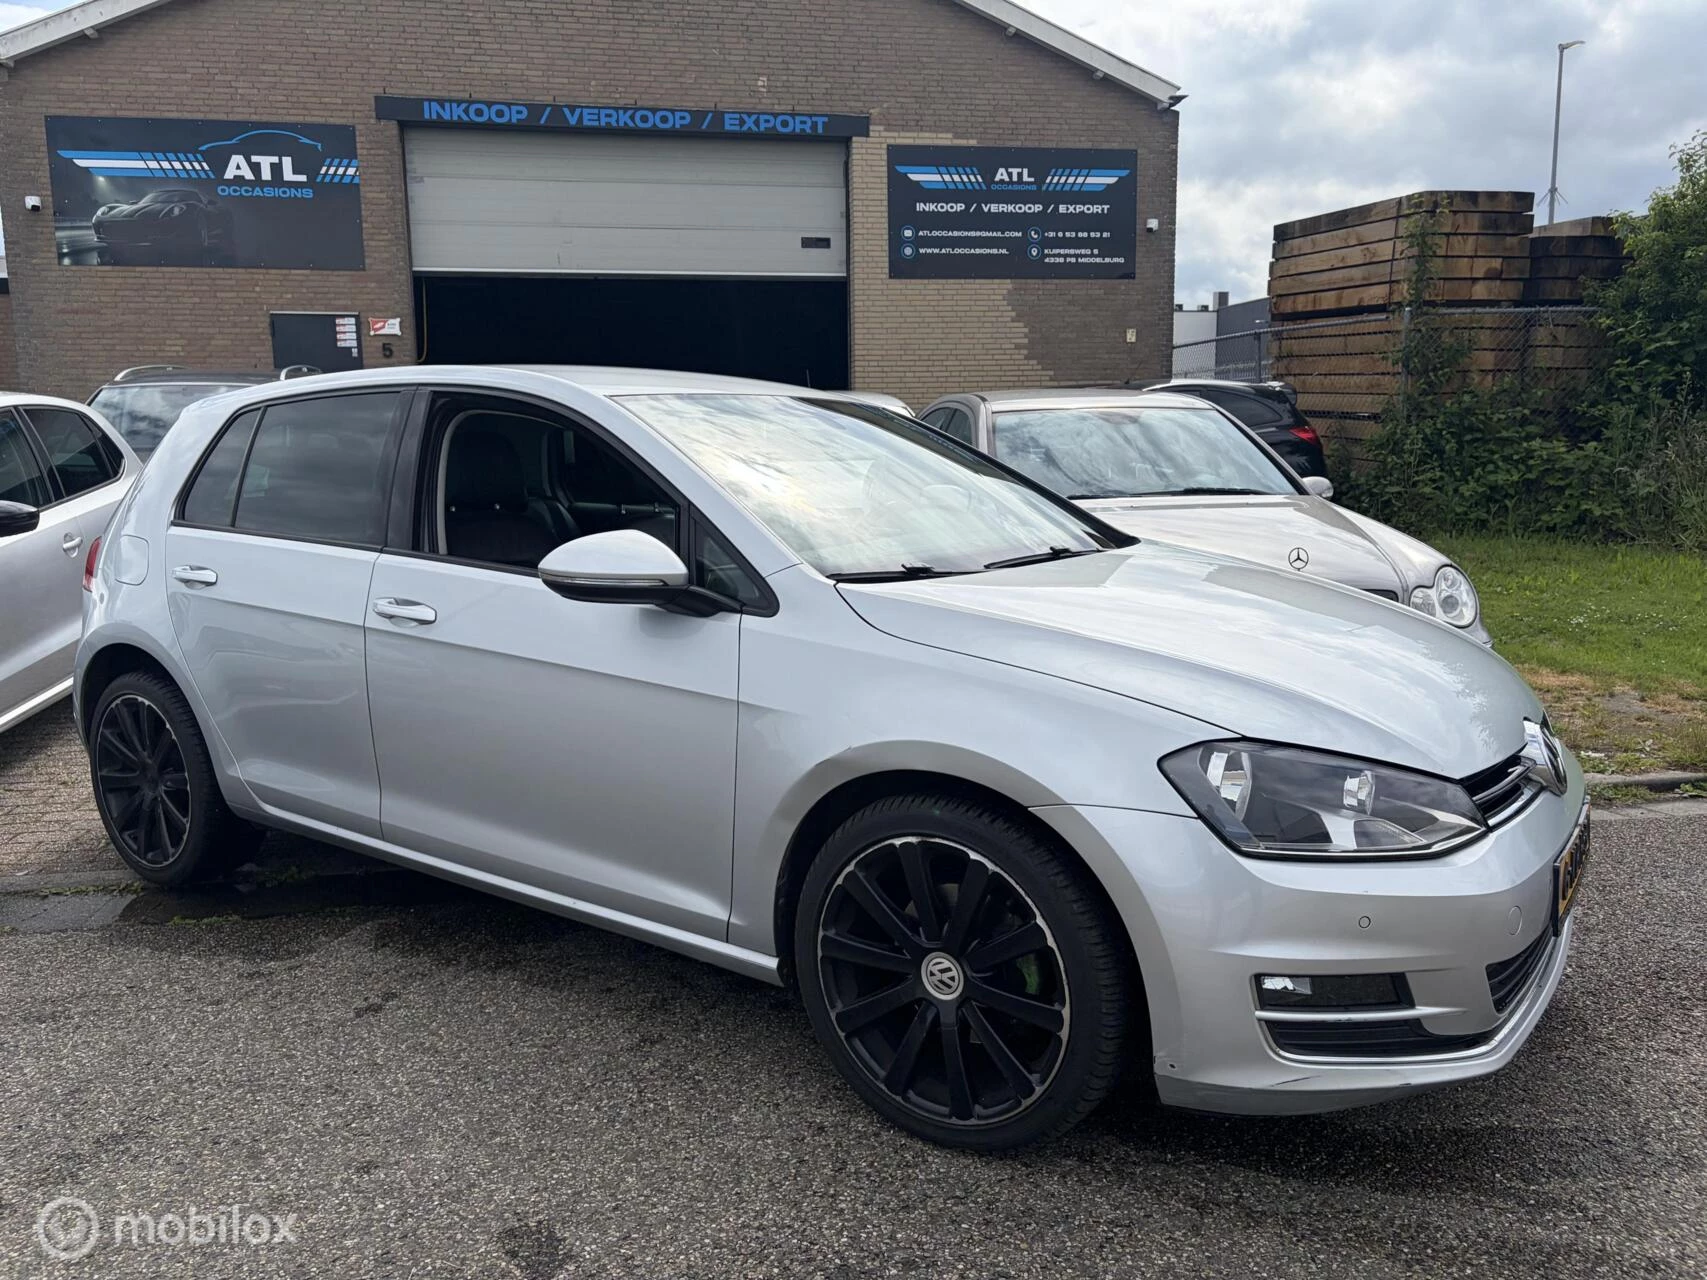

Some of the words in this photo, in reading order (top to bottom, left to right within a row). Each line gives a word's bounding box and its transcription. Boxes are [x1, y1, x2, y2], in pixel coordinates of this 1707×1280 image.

[422, 100, 528, 124] INKOOP
[539, 106, 552, 124] /
[562, 107, 691, 129] VERKOOP
[701, 112, 712, 129] /
[723, 113, 829, 135] EXPORT
[223, 154, 308, 182] ATL
[993, 167, 1035, 182] ATL
[217, 185, 314, 198] OCCASIONS
[915, 202, 965, 213] INKOOP
[981, 203, 1043, 214] VERKOOP
[1058, 204, 1110, 214] EXPORT
[382, 342, 394, 358] 5
